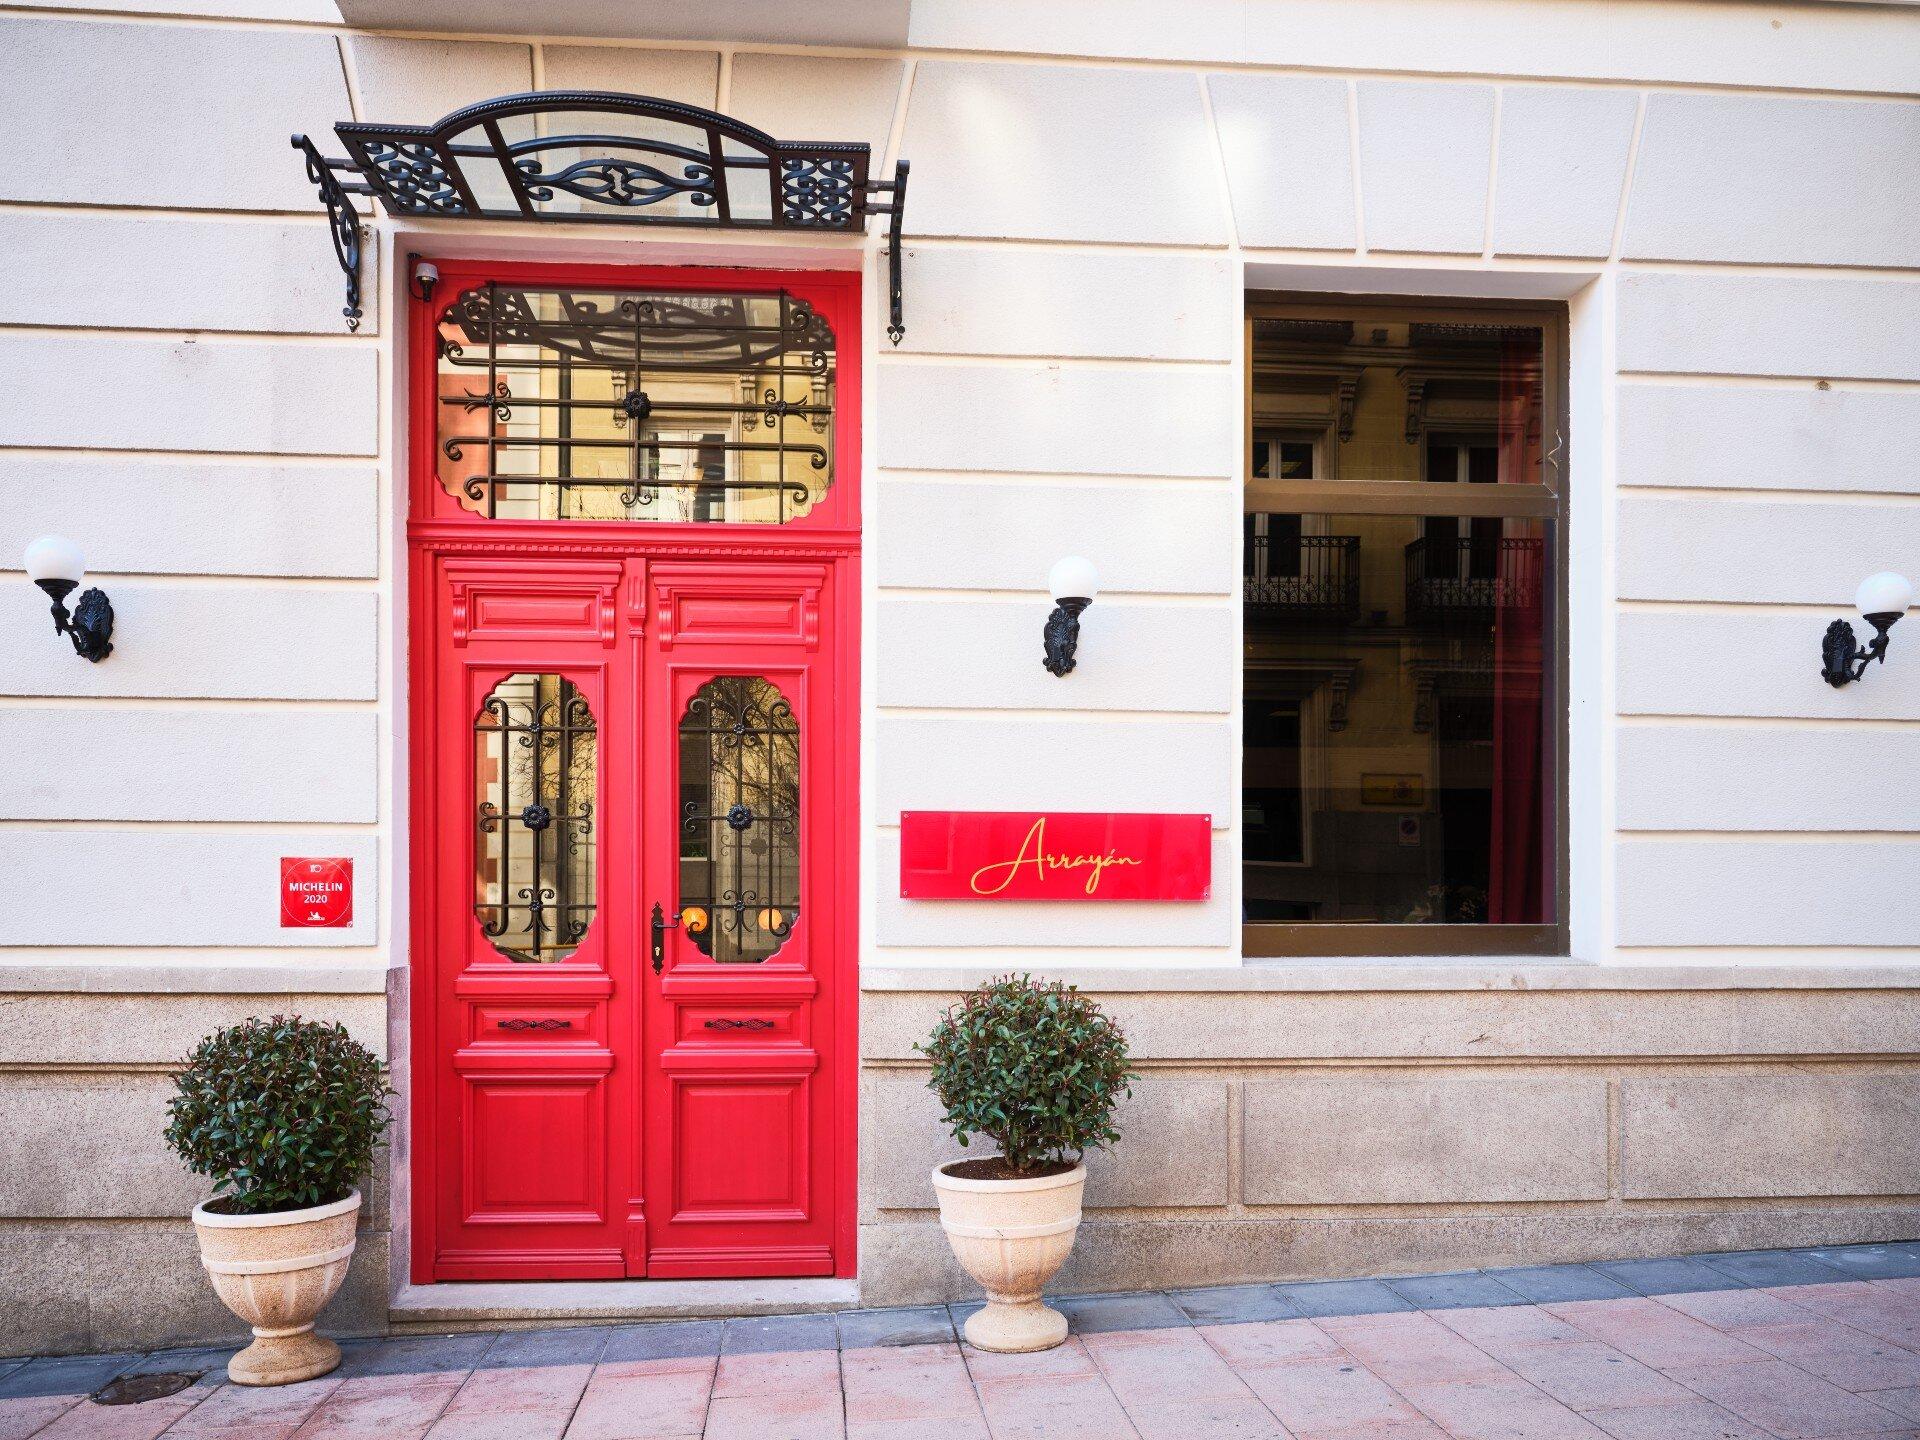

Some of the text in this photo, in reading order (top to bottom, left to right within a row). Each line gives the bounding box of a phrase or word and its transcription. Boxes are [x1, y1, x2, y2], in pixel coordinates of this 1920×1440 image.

[970, 816, 1142, 895] Arrayán
[289, 882, 343, 892] MICHELIN
[303, 894, 328, 904] 2020
